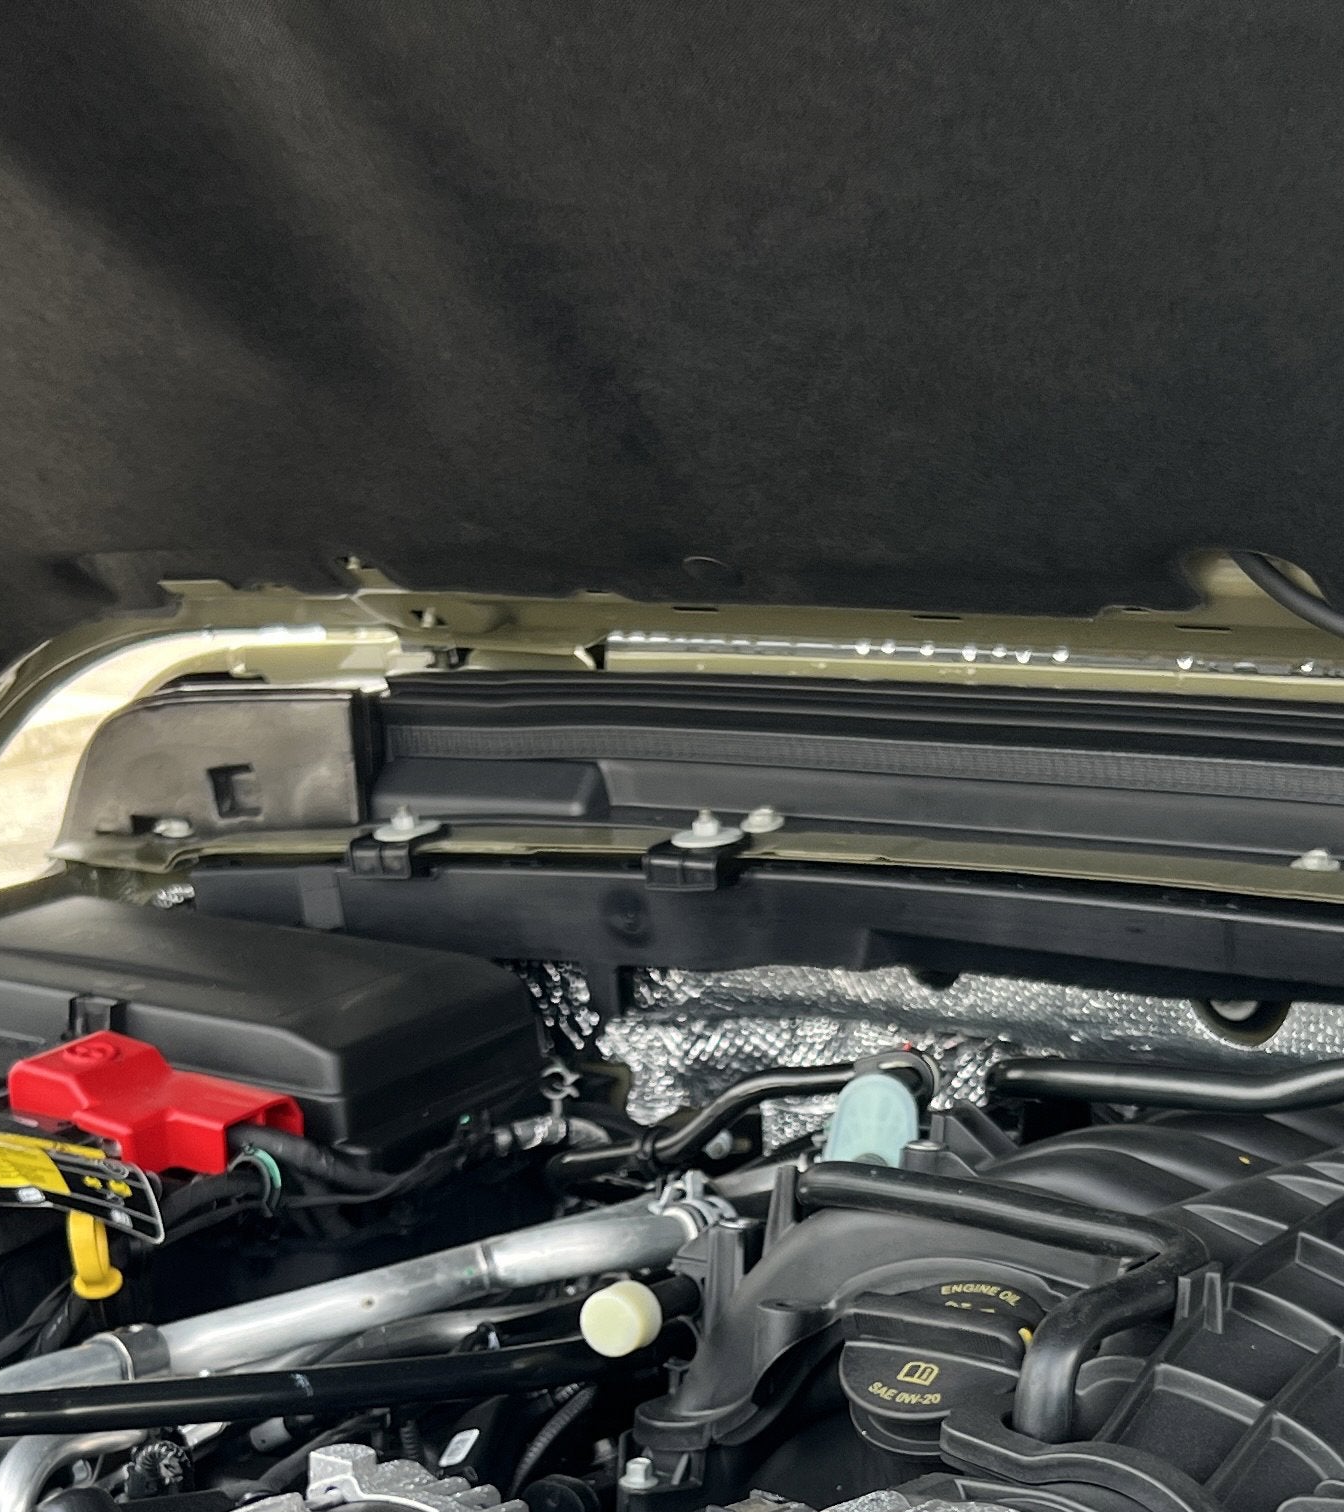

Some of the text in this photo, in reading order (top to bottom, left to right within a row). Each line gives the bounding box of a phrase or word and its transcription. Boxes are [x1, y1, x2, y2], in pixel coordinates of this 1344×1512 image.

[940, 1283, 1001, 1297] ENGINE
[998, 1290, 1022, 1308] OIL
[867, 1381, 942, 1405] SAE 0W-20
